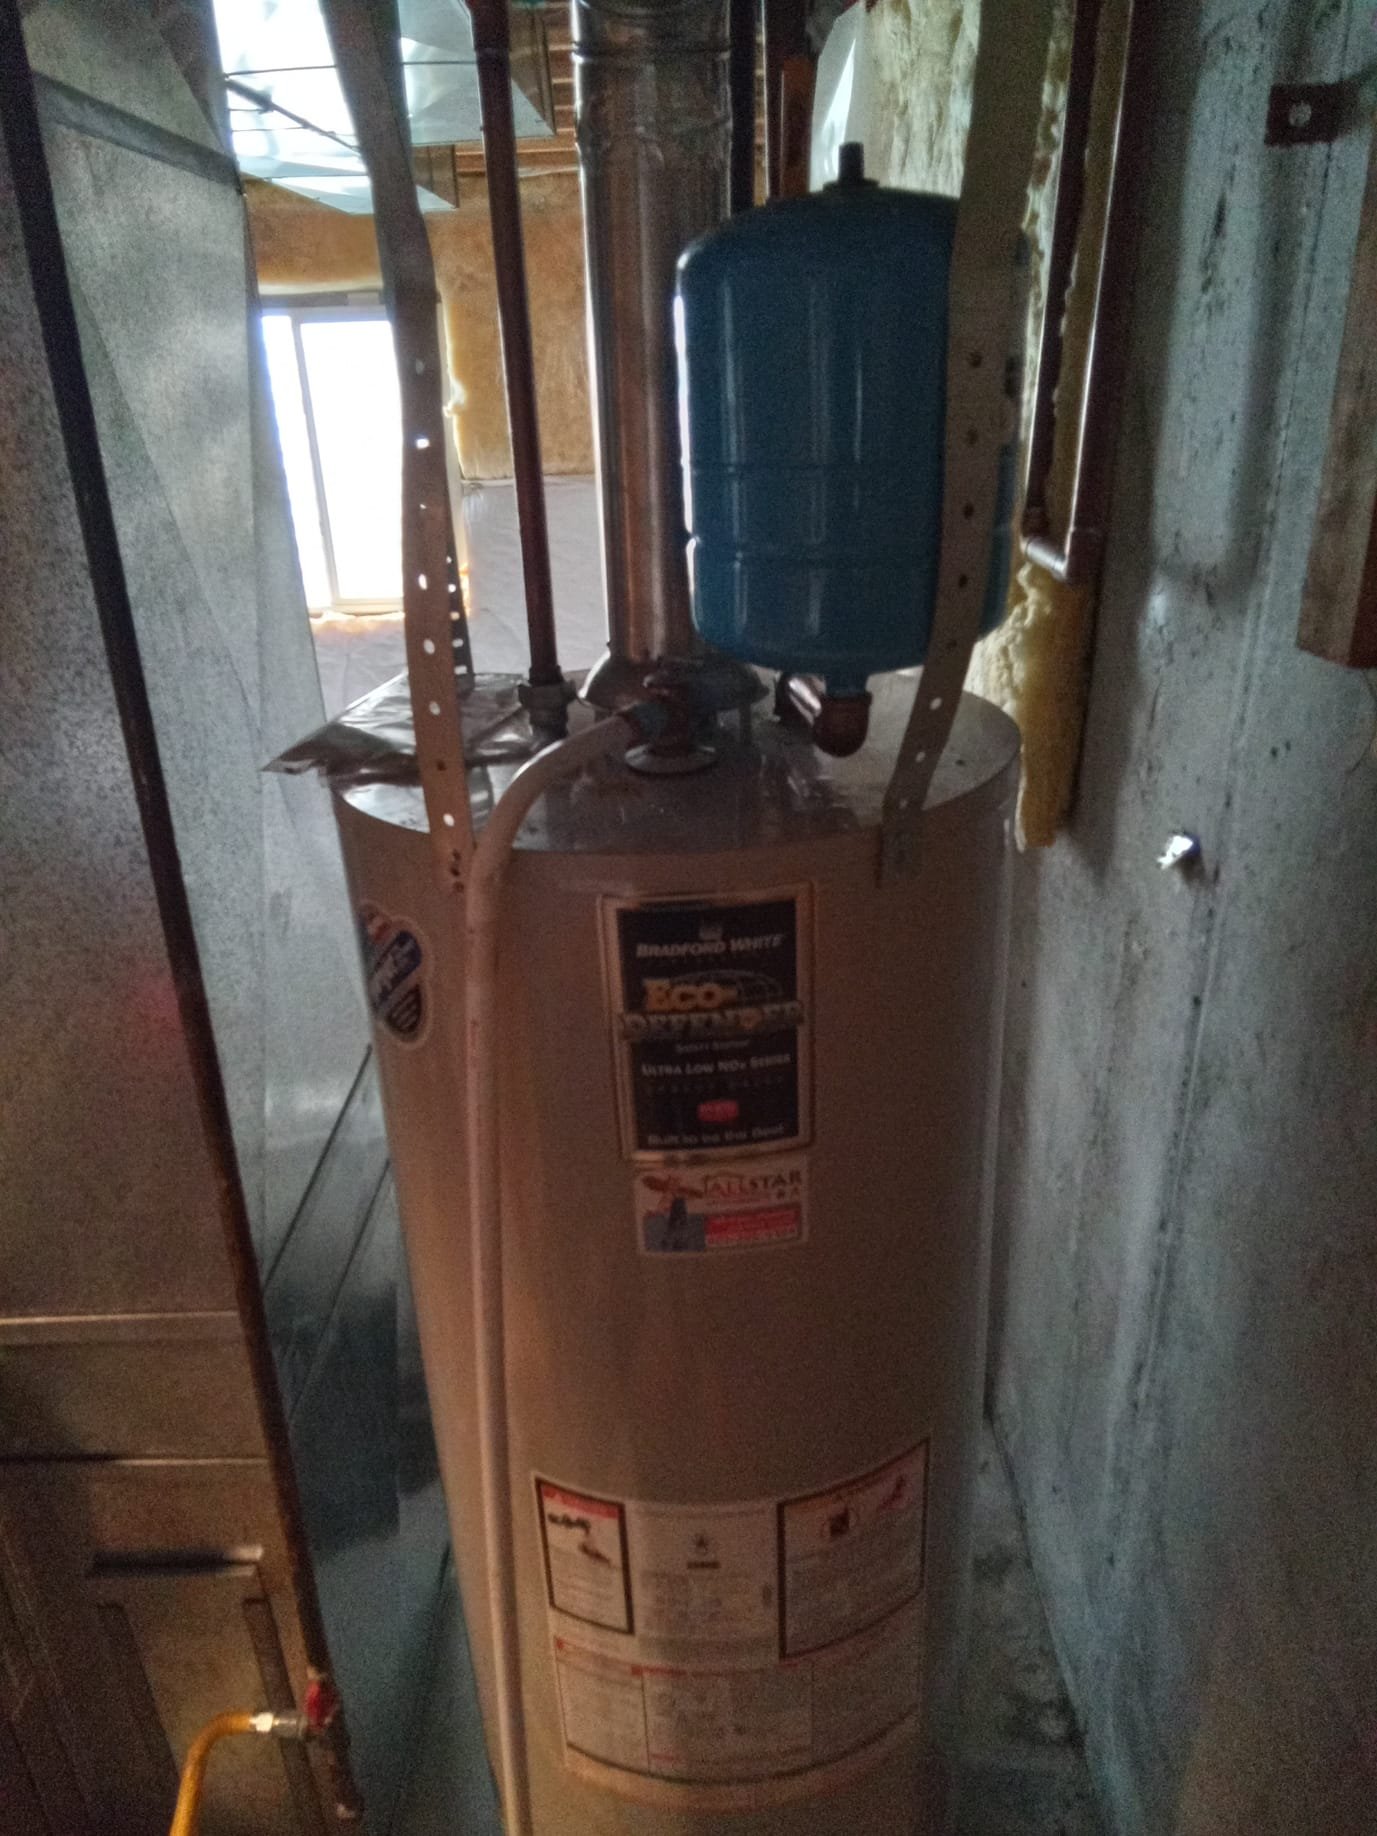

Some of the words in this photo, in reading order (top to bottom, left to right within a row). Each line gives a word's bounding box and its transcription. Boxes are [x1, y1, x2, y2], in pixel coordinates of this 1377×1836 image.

[636, 940, 726, 958] BRADFORD
[729, 933, 784, 952] WHITE
[641, 1063, 682, 1077] ULTRA
[685, 1062, 715, 1075] LOW
